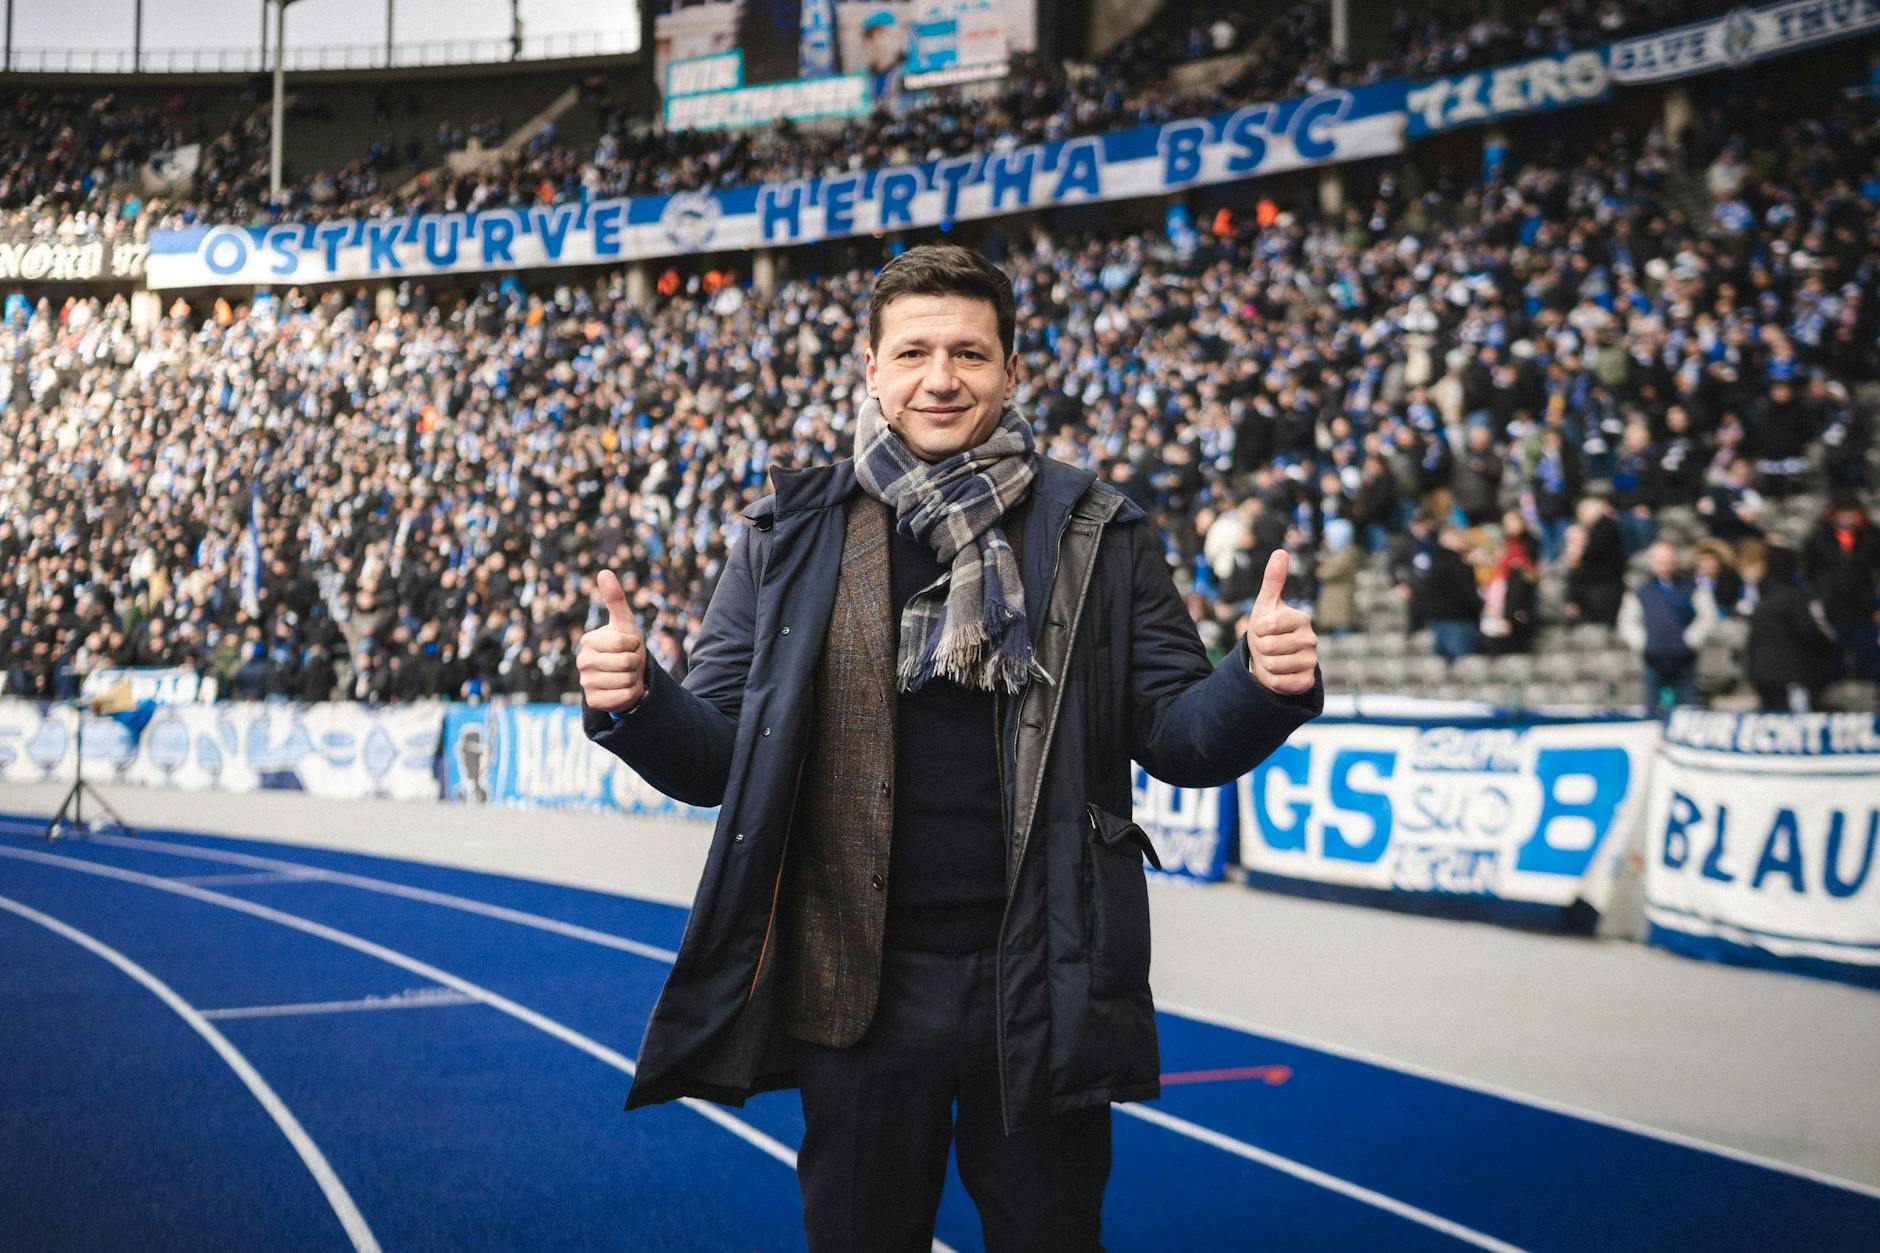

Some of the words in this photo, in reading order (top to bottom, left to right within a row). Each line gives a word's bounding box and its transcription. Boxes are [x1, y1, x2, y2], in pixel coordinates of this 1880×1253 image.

[200, 200, 628, 277] OSTKURVE
[757, 136, 1102, 239] HERTHA
[1159, 88, 1349, 185] BSC
[1252, 742, 1397, 865] GS
[1664, 790, 1880, 897] BLAU
